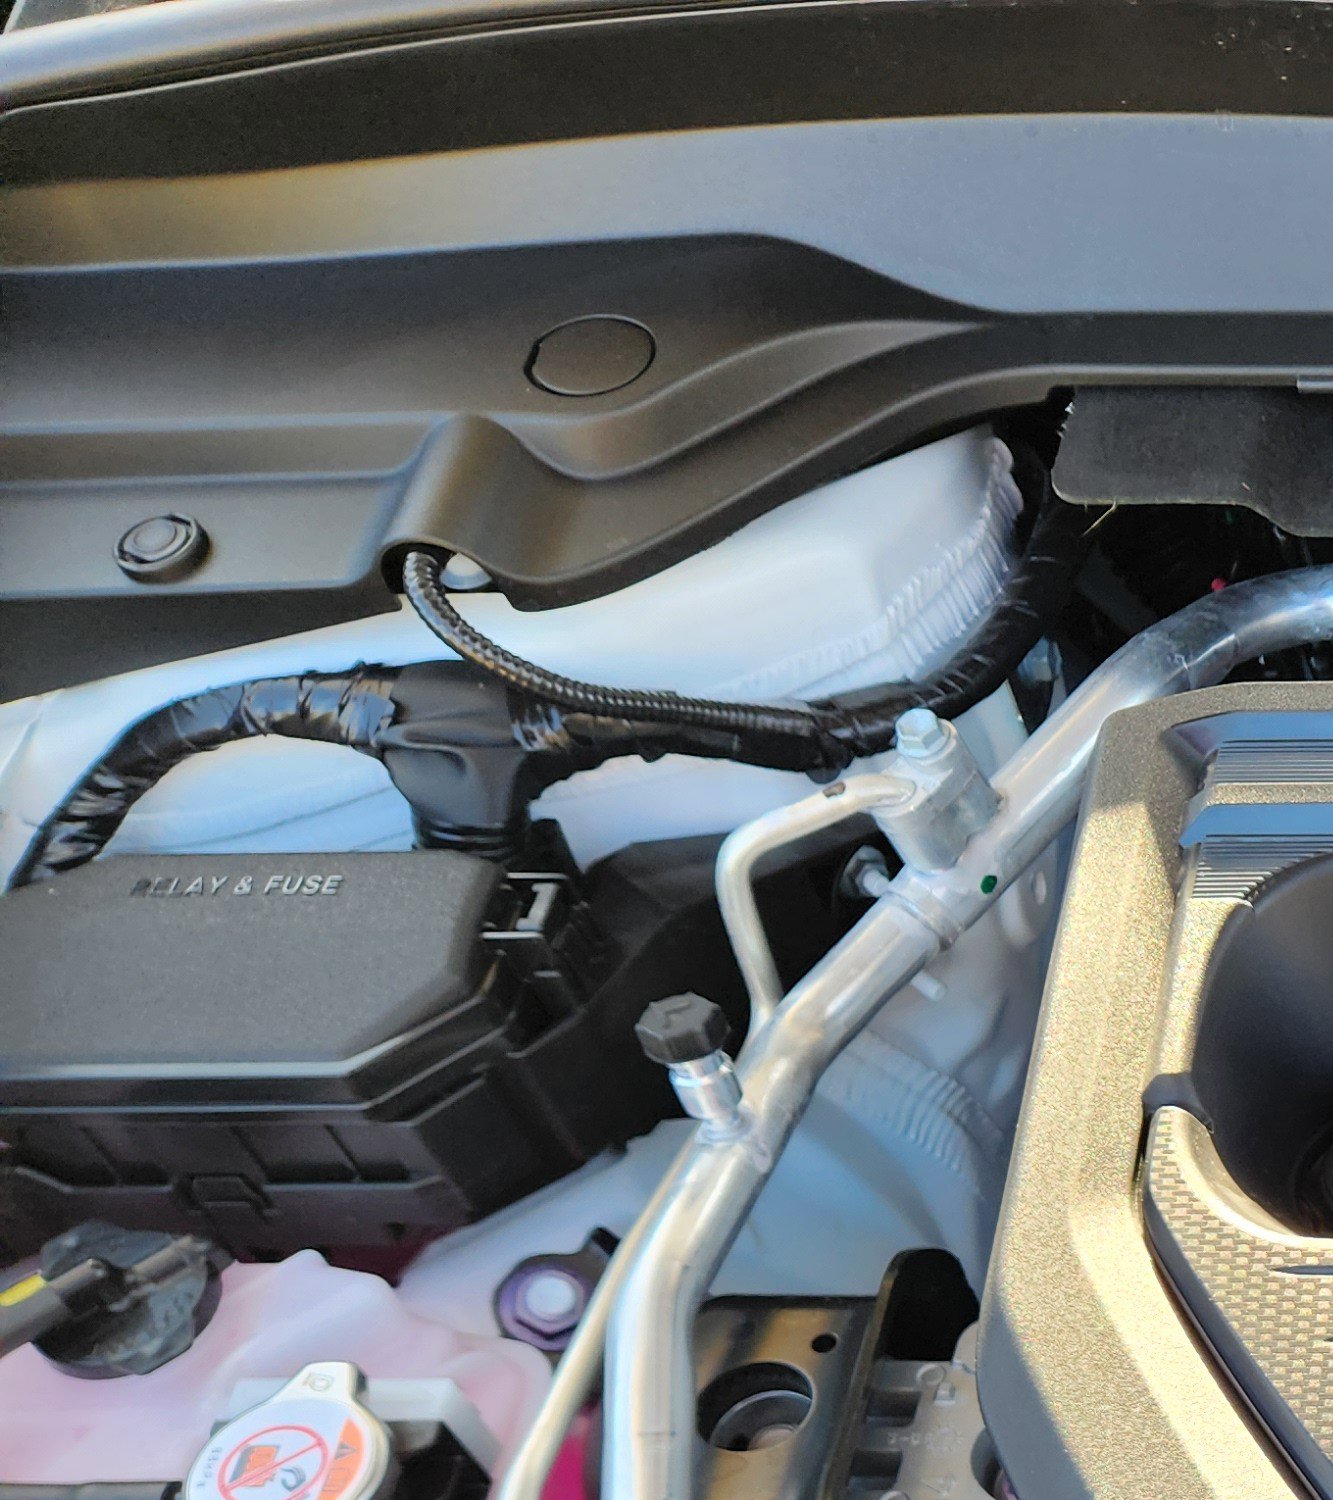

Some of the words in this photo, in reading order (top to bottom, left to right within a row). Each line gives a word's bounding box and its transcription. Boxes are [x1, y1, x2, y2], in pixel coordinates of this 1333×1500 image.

[130, 875, 228, 898] RELAY
[233, 875, 252, 896] &
[263, 874, 344, 896] FUSE
